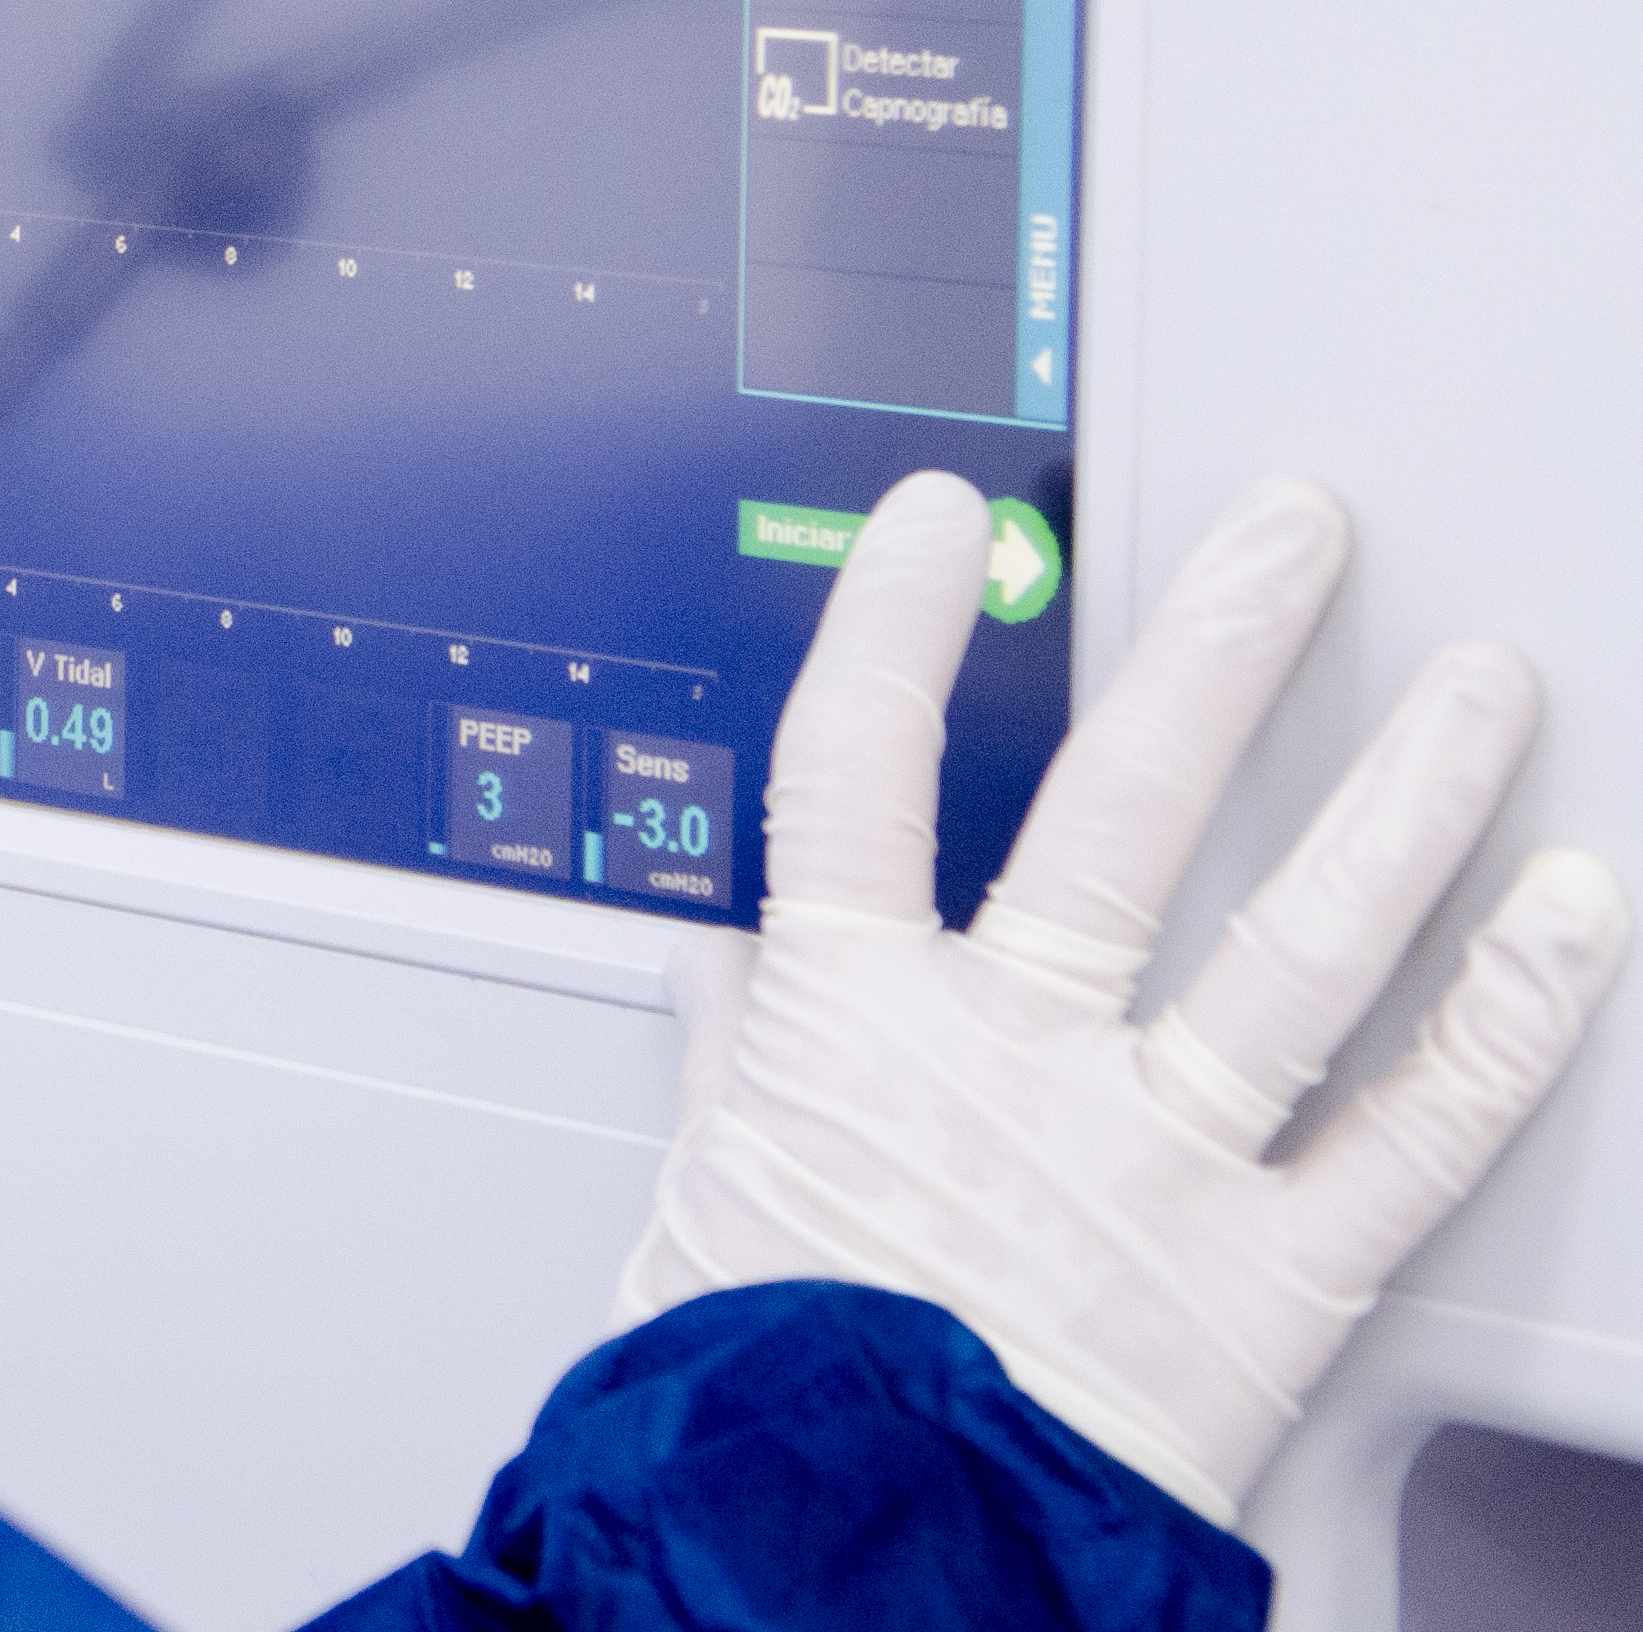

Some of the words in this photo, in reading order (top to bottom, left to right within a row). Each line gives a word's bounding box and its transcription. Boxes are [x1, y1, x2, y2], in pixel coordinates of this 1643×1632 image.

[841, 42, 960, 79] Detectar
[841, 88, 1008, 132] Capnografía
[9, 224, 21, 243] 4
[337, 258, 357, 278] 10
[454, 270, 475, 291] 12
[574, 281, 595, 303] 14
[1027, 212, 1059, 321] MENU
[755, 514, 853, 553] Iniciar
[5, 578, 17, 597] 4
[110, 593, 123, 612] 6
[332, 627, 352, 647] 10
[448, 644, 470, 666] 12
[568, 661, 590, 684] 14
[26, 650, 45, 677] V
[54, 654, 112, 689] Tidal
[25, 696, 113, 755] 0.49
[459, 718, 533, 756] PEEP
[103, 773, 114, 790] L
[616, 743, 690, 783] Sens
[477, 770, 503, 821] 3
[613, 798, 709, 857] -3.0
